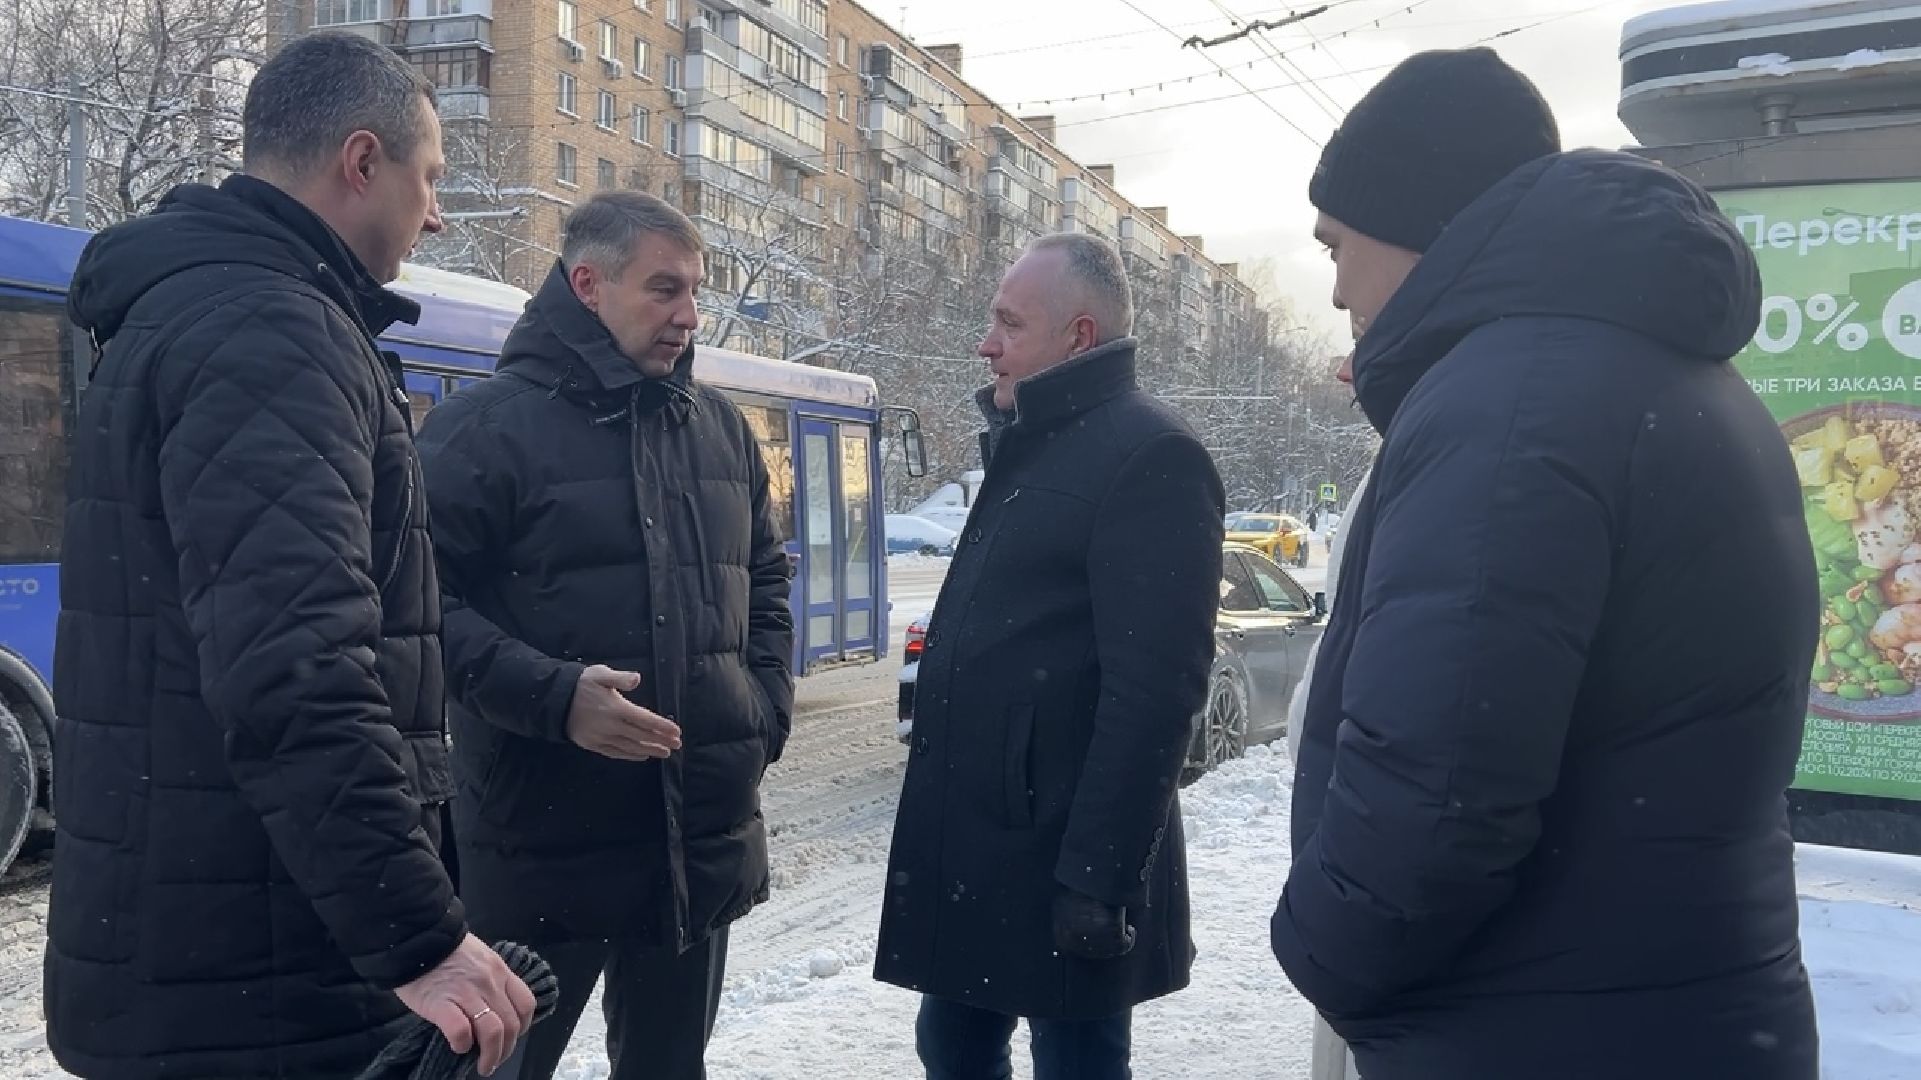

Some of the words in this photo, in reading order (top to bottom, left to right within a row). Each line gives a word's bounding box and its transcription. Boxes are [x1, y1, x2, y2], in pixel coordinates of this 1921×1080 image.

[1740, 293, 1869, 353] 0%
[1745, 378, 1779, 394] ЫЕ
[1783, 377, 1821, 393] ТРИ
[1827, 375, 1907, 391] ЗАКАЗА
